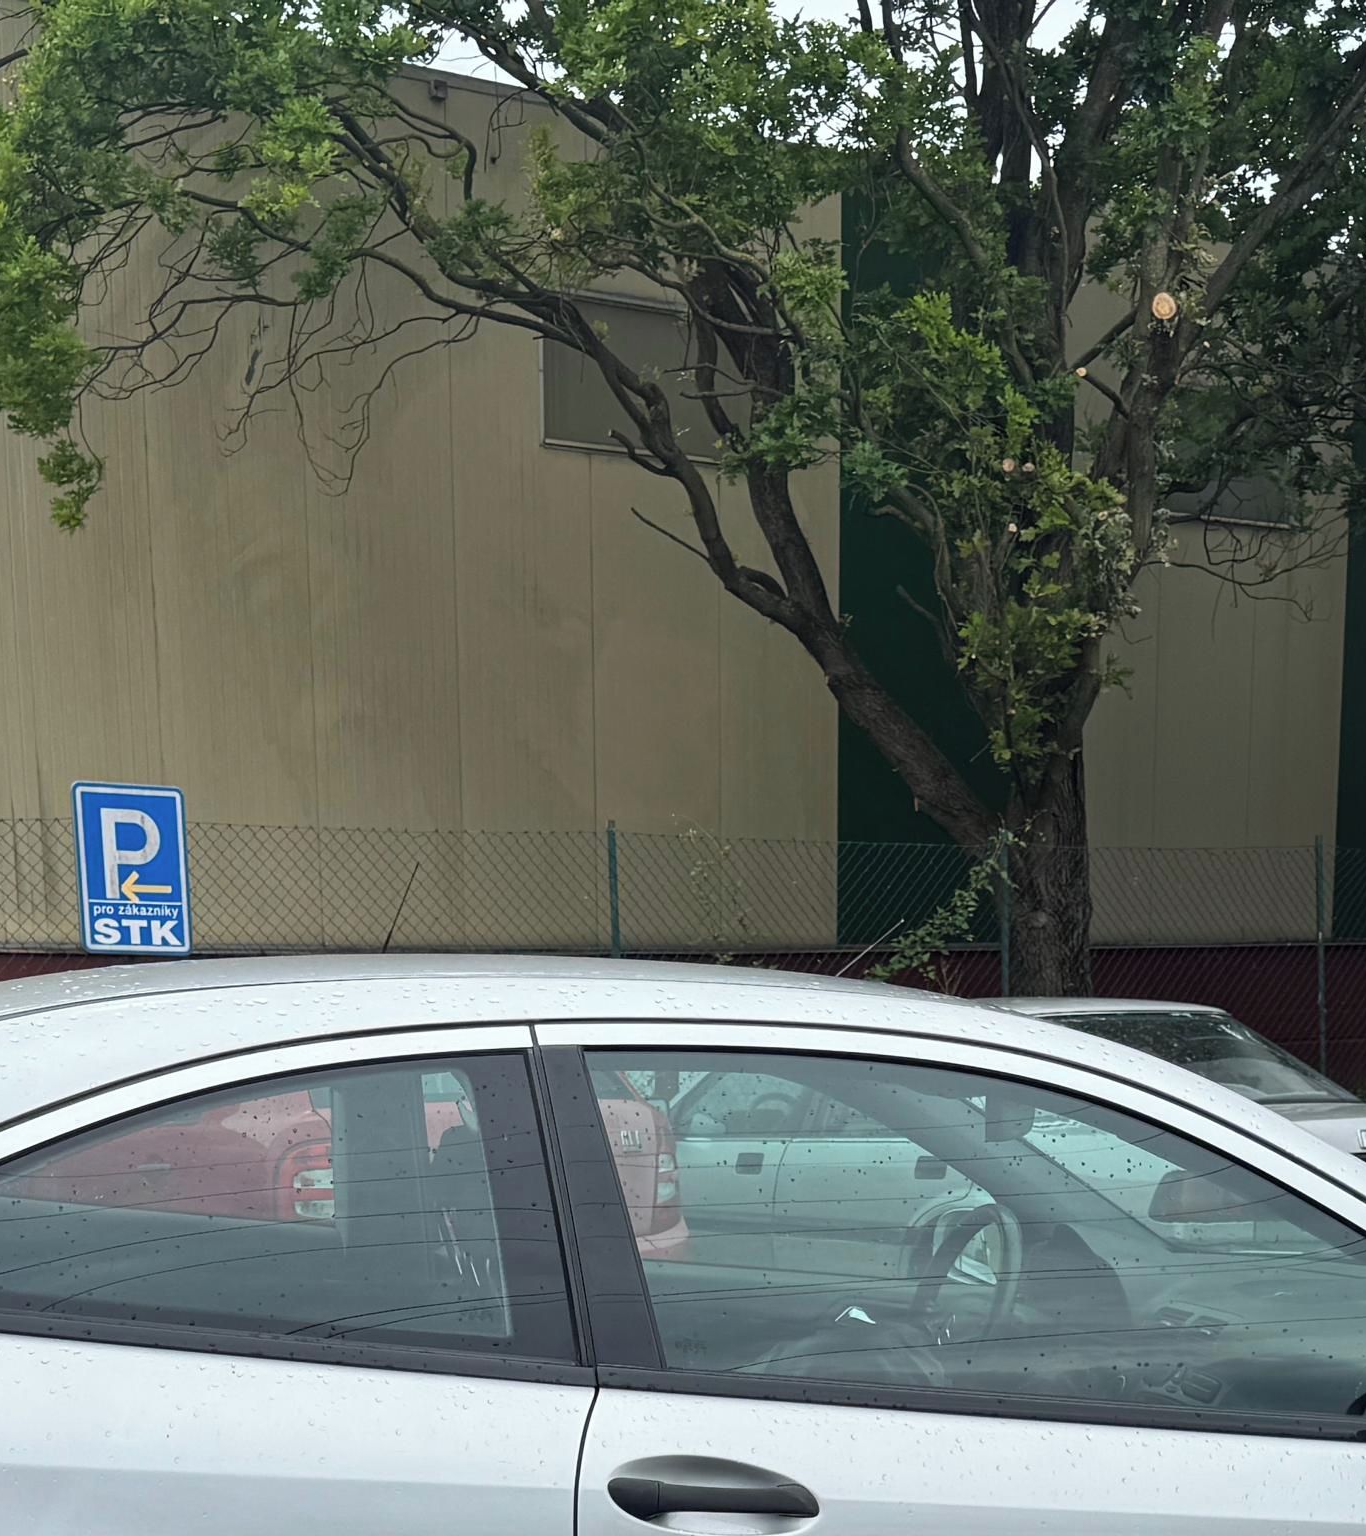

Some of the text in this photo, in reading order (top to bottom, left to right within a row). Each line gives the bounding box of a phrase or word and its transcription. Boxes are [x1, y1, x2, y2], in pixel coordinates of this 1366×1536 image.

[100, 807, 161, 899] P
[93, 903, 179, 919] pro zákazníky
[93, 917, 183, 946] STK
